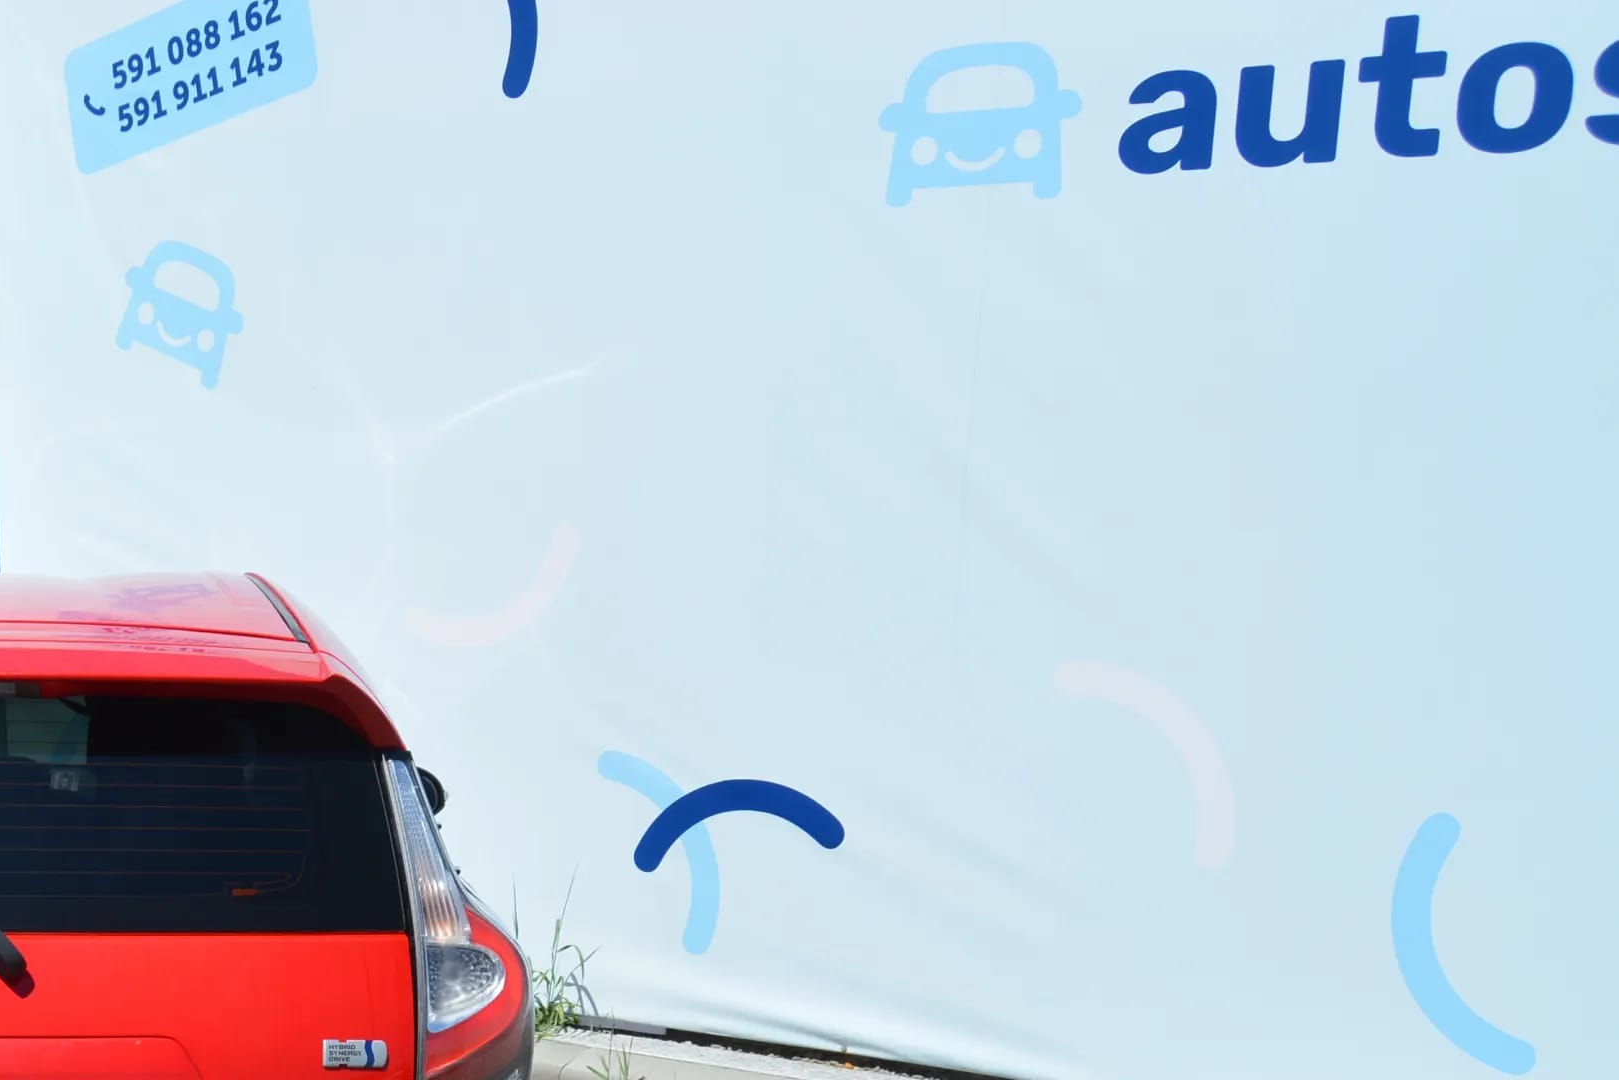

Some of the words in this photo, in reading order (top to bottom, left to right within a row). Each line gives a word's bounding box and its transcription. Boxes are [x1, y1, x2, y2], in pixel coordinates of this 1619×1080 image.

[111, 46, 162, 90] 591
[167, 19, 221, 66] 088
[228, 0, 282, 41] 162
[117, 89, 168, 133] 591
[172, 66, 224, 111] 911
[229, 40, 283, 88] 143
